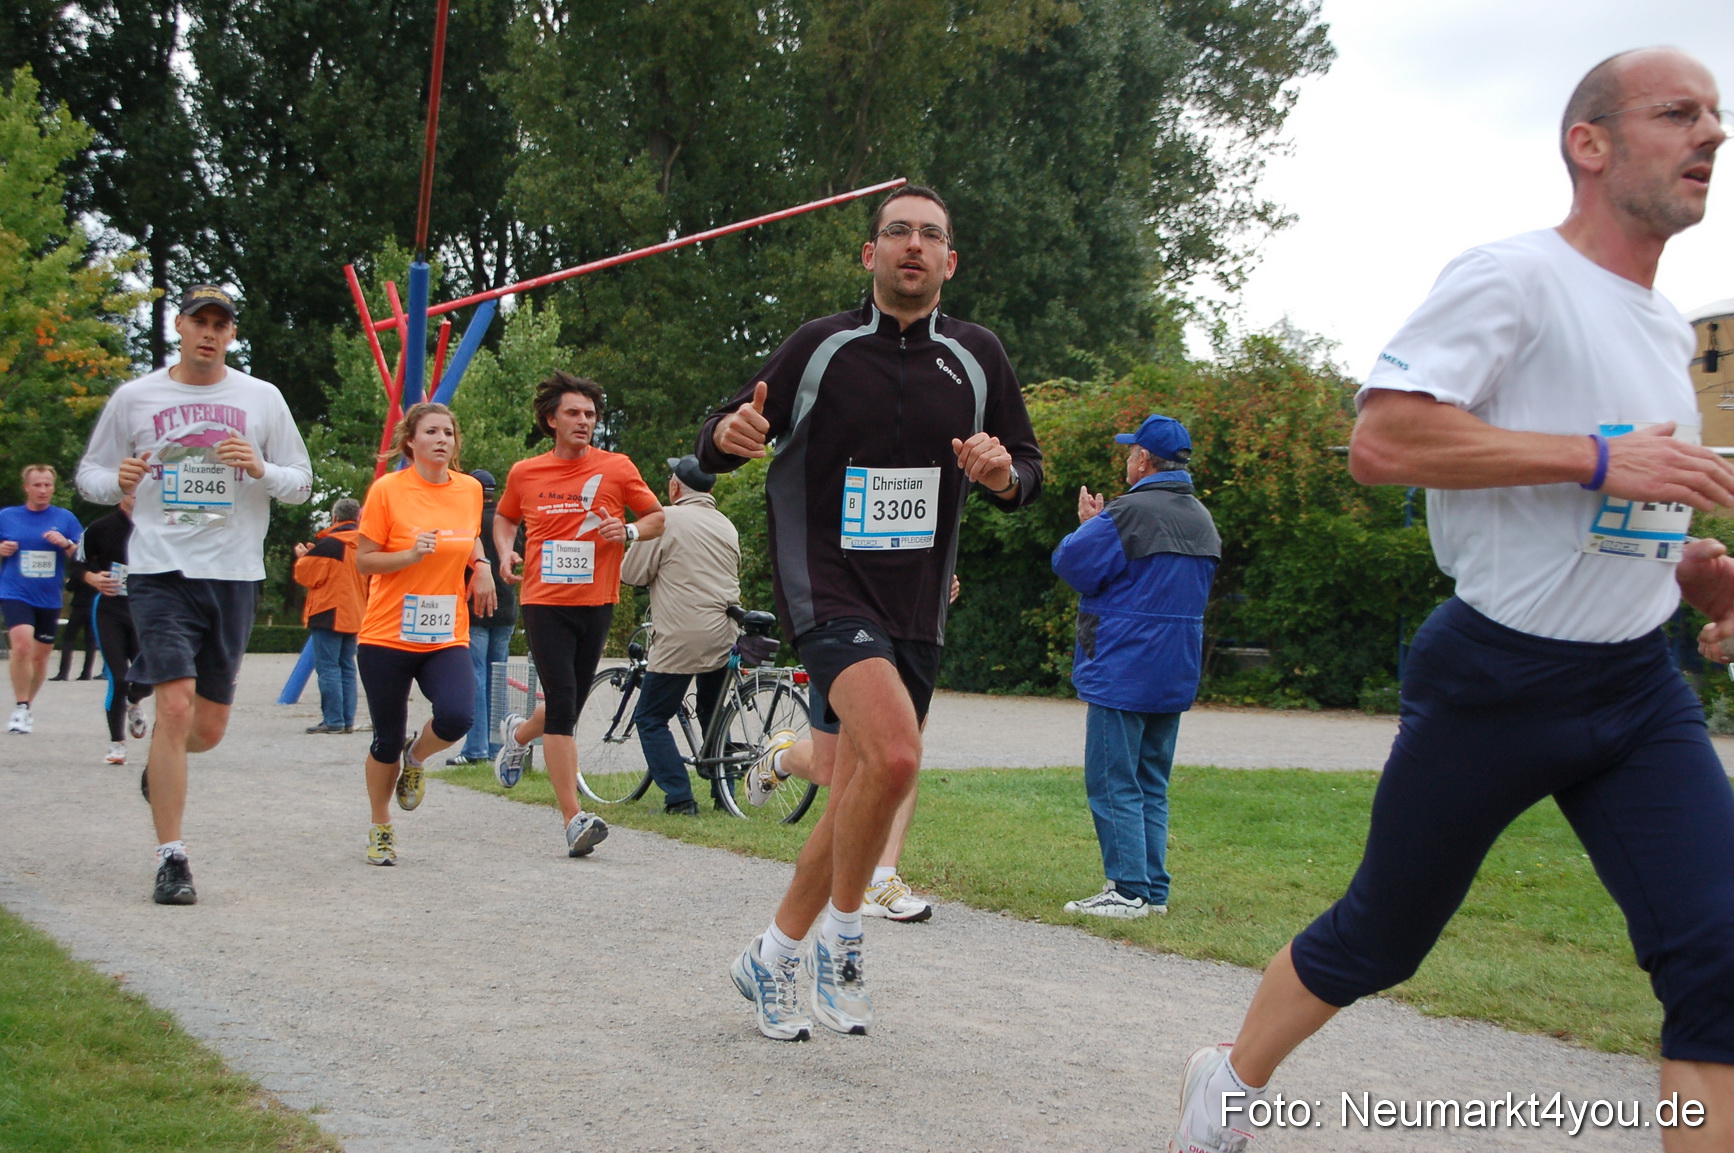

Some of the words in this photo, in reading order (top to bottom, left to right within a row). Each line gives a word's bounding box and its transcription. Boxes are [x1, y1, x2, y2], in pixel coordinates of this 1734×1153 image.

[180, 403, 248, 437] VERNON
[183, 463, 226, 475] Alexander
[183, 479, 227, 495] 2846
[873, 476, 923, 491] Christian
[567, 494, 589, 503] 2008
[849, 497, 856, 509] B
[872, 498, 927, 521] 3306
[556, 544, 581, 553] Thomas
[32, 560, 52, 569] 2889
[556, 557, 588, 569] 3332
[421, 599, 439, 609] Anika
[420, 613, 451, 626] 2812
